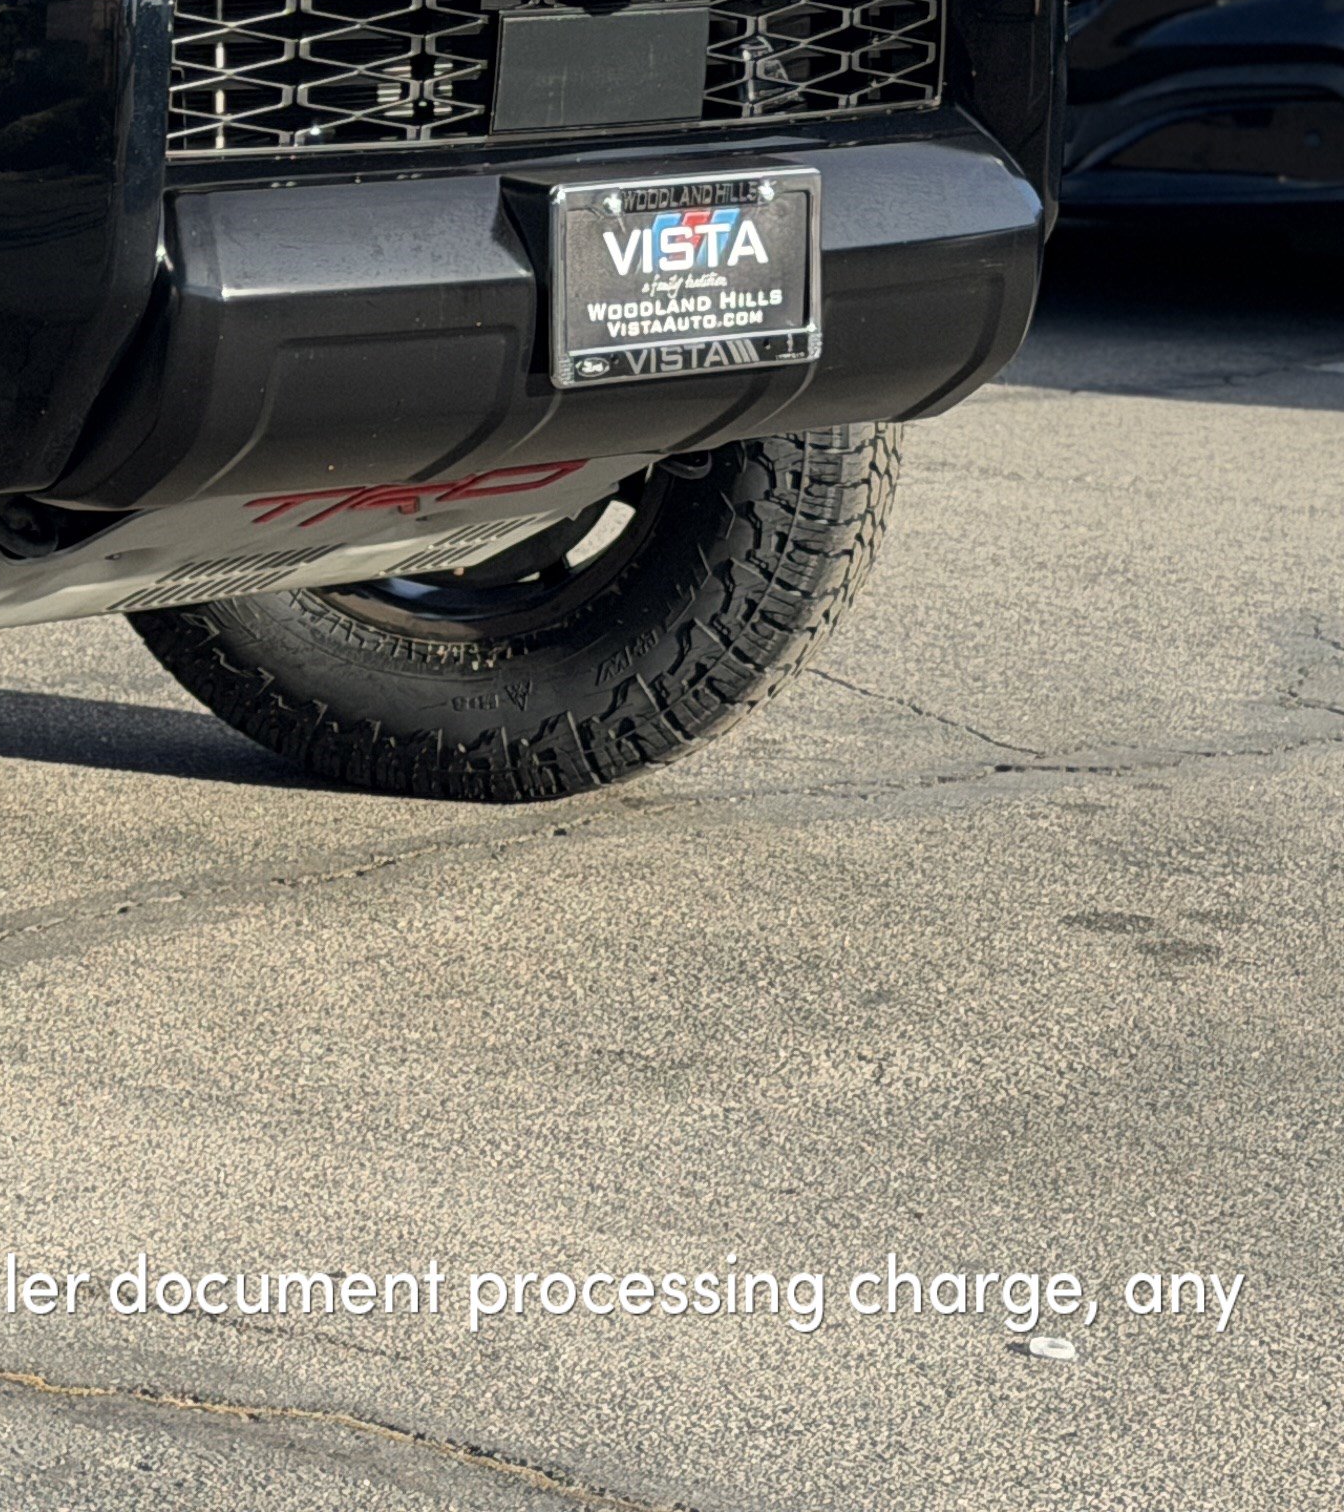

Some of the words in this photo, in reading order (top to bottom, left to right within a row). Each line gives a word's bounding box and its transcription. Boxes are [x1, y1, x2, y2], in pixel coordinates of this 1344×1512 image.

[622, 185, 713, 210] WOODLAND
[715, 182, 759, 204] HILLS
[603, 219, 769, 276] VISTA
[586, 296, 712, 322] WOODLAND
[718, 289, 784, 311] HILLS
[625, 340, 730, 375] VISTA
